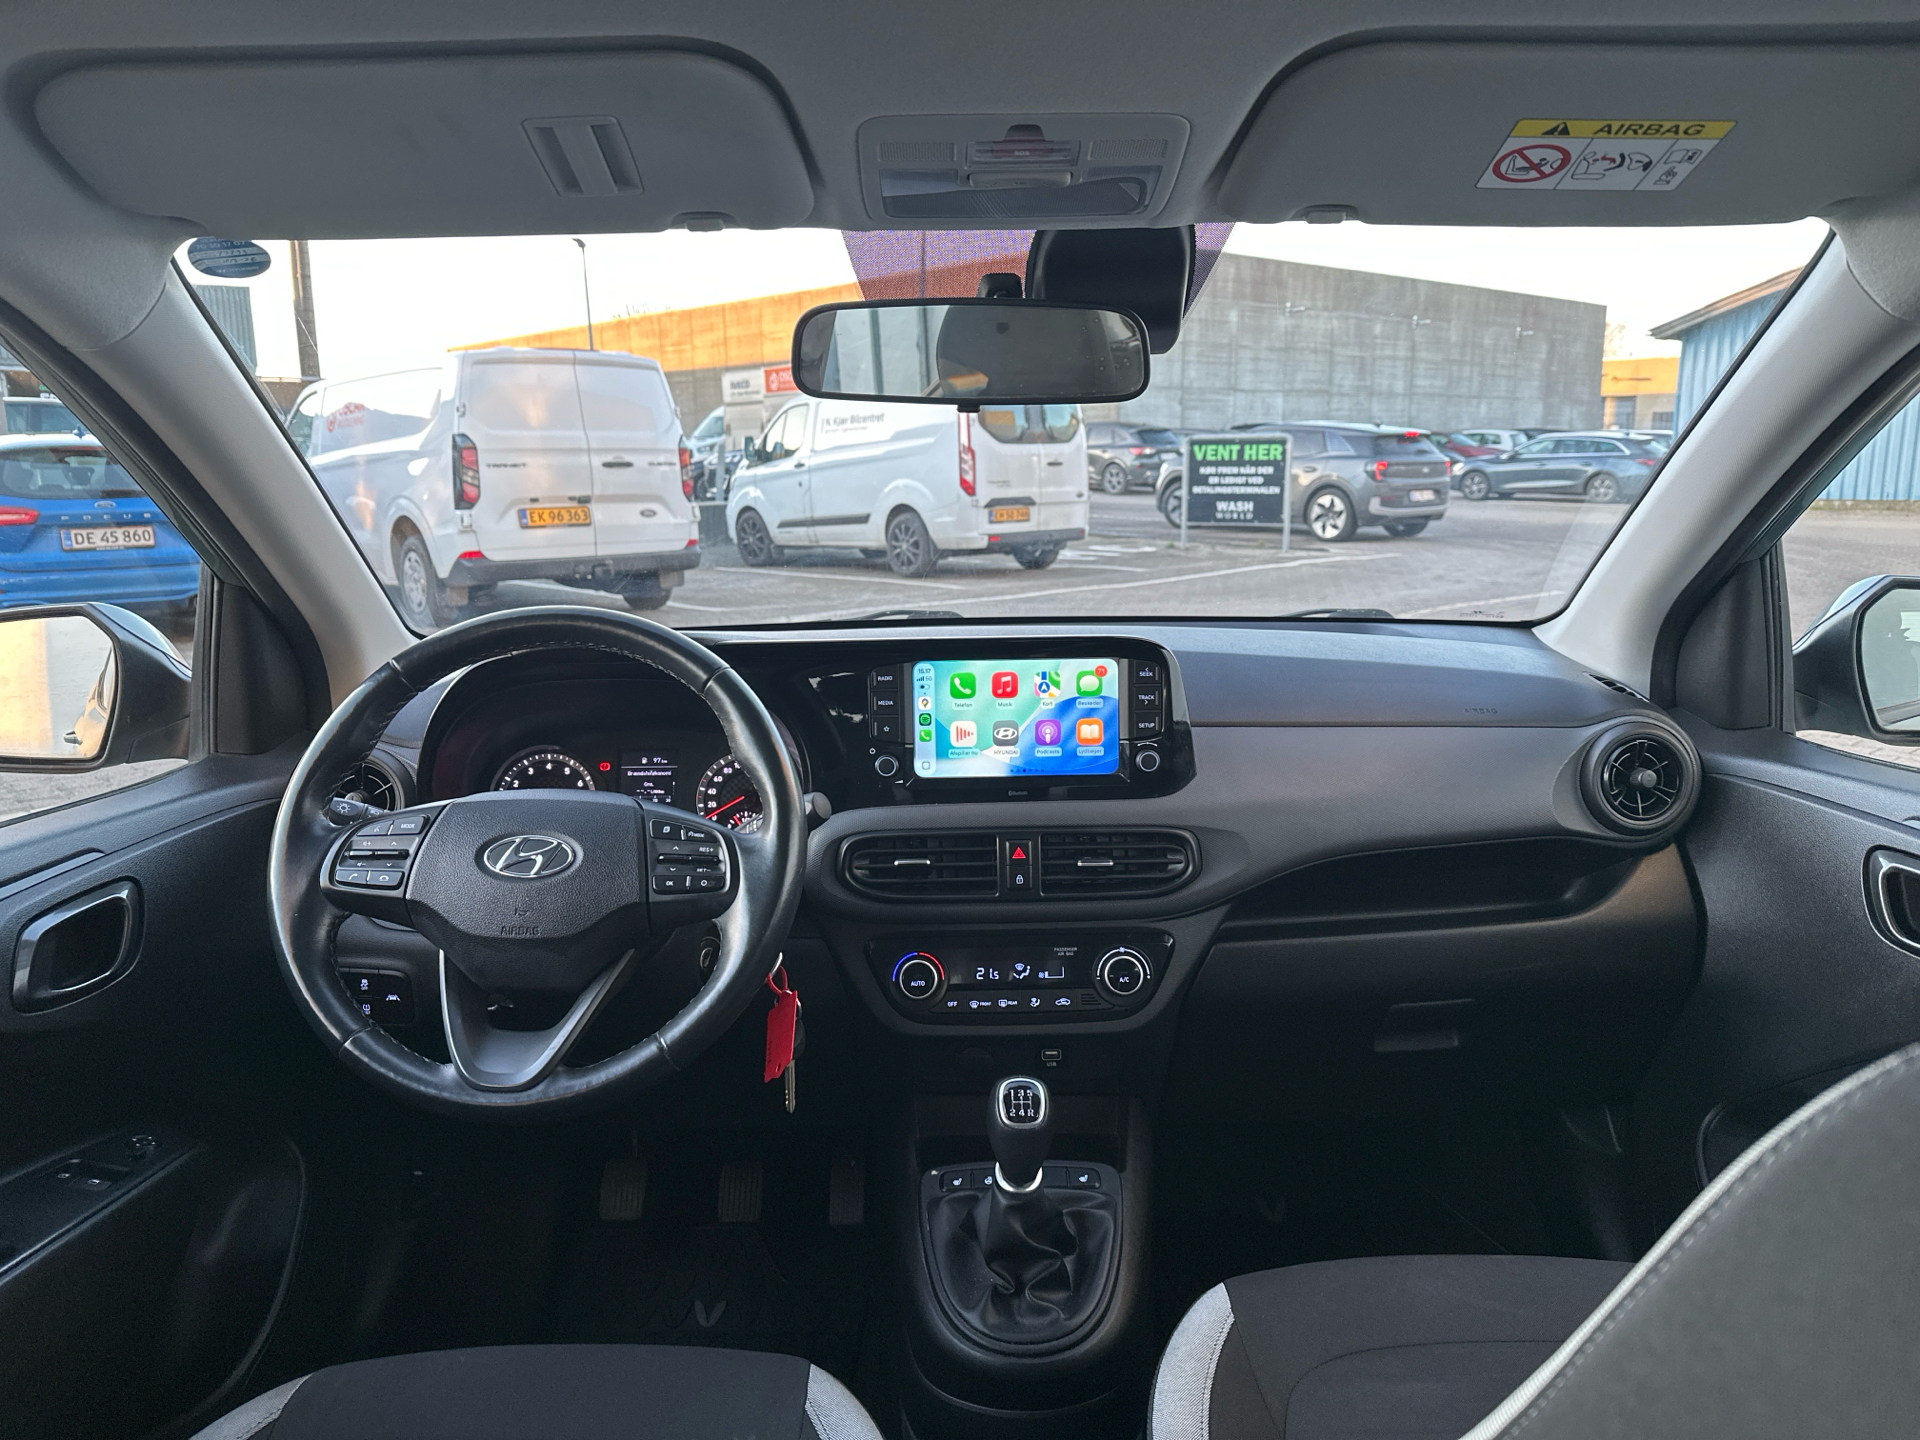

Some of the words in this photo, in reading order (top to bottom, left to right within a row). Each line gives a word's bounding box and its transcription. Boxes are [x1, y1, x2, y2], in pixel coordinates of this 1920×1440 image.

[1592, 123, 1707, 136] AIRBAG
[1193, 444, 1241, 461] VENT
[1243, 443, 1283, 461] HER
[1199, 466, 1217, 475] KØR
[1217, 466, 1239, 475] FREM
[1240, 464, 1257, 475] NÅR
[1257, 466, 1275, 475] DER
[1208, 476, 1220, 485] ER
[1220, 476, 1247, 485] LEDIGT
[1248, 476, 1265, 485] VED
[1215, 501, 1254, 512] WASH
[61, 512, 151, 521] FOCUS
[529, 511, 547, 524] EK
[548, 510, 564, 523] 96
[567, 509, 590, 522] 363
[1215, 511, 1254, 520] WORLD
[73, 532, 96, 546] DE
[100, 530, 119, 544] 45
[123, 529, 152, 543] 860
[1464, 707, 1498, 715] AIRBAG
[546, 762, 552, 770] 4
[528, 767, 534, 775] 3
[564, 767, 571, 775] 5
[513, 779, 519, 788] 2
[577, 779, 584, 788] 6
[500, 925, 541, 936] AIRBAG
[1017, 1089, 1024, 1097] 3
[1026, 1089, 1033, 1097] 5
[1009, 1109, 1016, 1117] 2
[1018, 1109, 1025, 1117] 4
[1027, 1109, 1035, 1117] R
